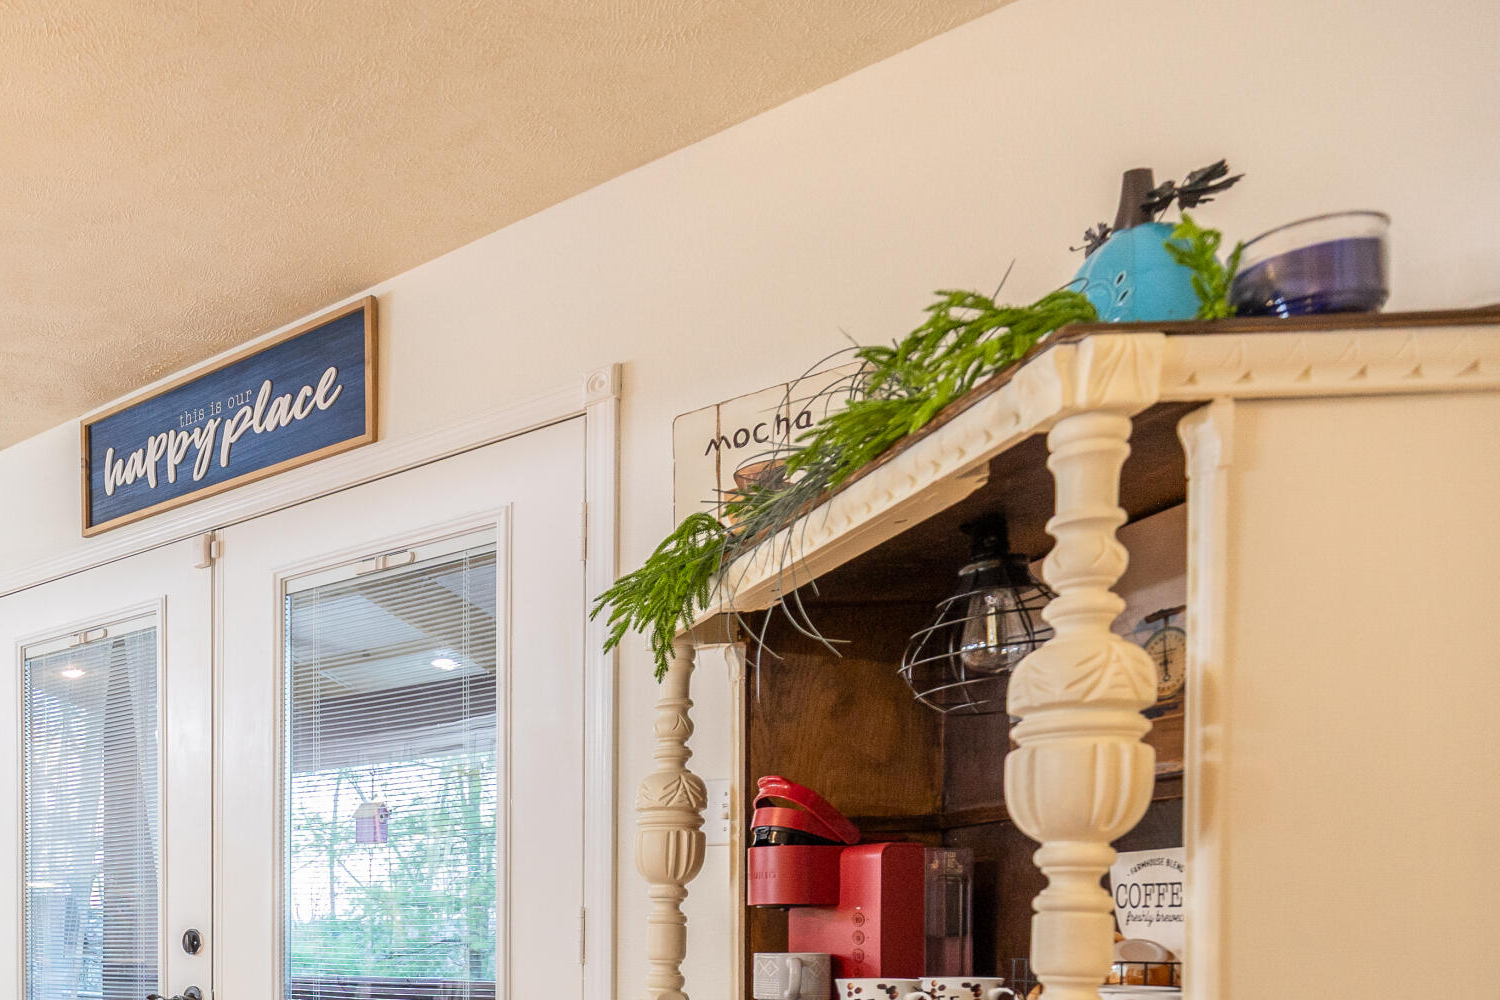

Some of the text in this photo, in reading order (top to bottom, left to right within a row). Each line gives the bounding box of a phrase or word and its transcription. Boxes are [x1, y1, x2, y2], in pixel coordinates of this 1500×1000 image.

[179, 388, 252, 428] this is our
[104, 367, 343, 496] happy place
[704, 410, 814, 456] mocha
[1115, 882, 1183, 909] COFFE
